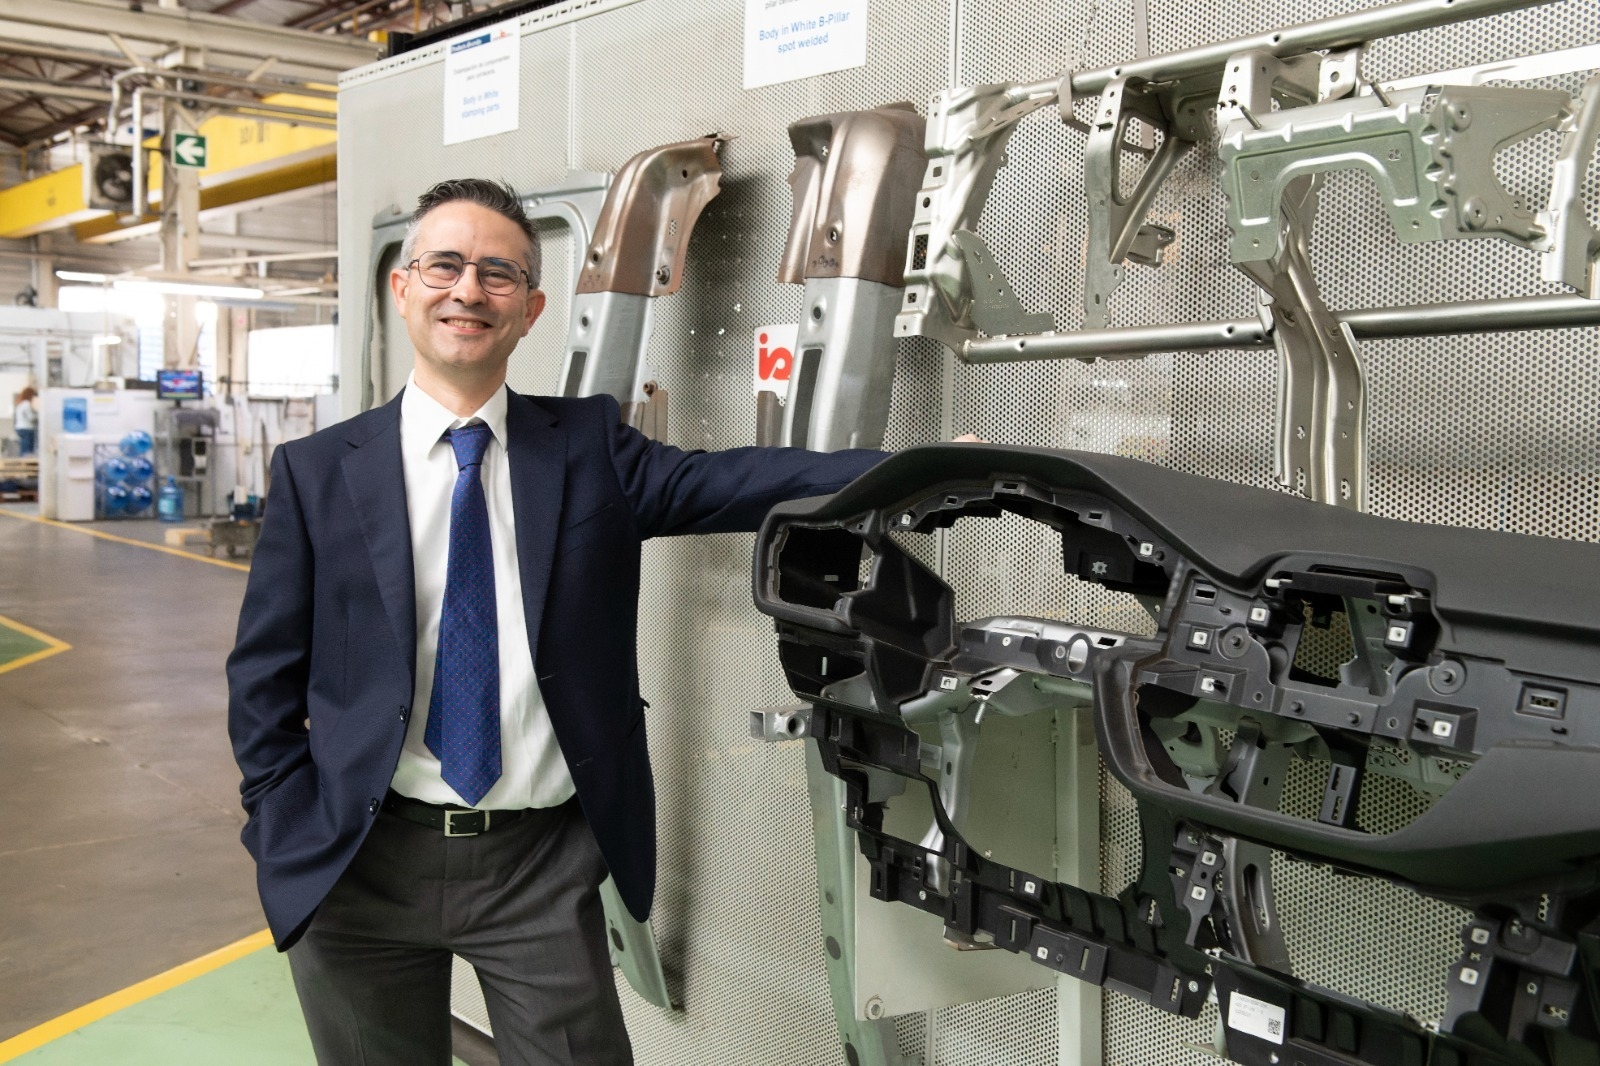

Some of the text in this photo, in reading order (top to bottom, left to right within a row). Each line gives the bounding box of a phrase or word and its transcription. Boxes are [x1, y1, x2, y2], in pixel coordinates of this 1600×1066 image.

[759, 11, 850, 41] Body in White B-Pillar
[778, 32, 829, 54] spot welded
[463, 96, 476, 105] Body
[484, 90, 499, 99] White
